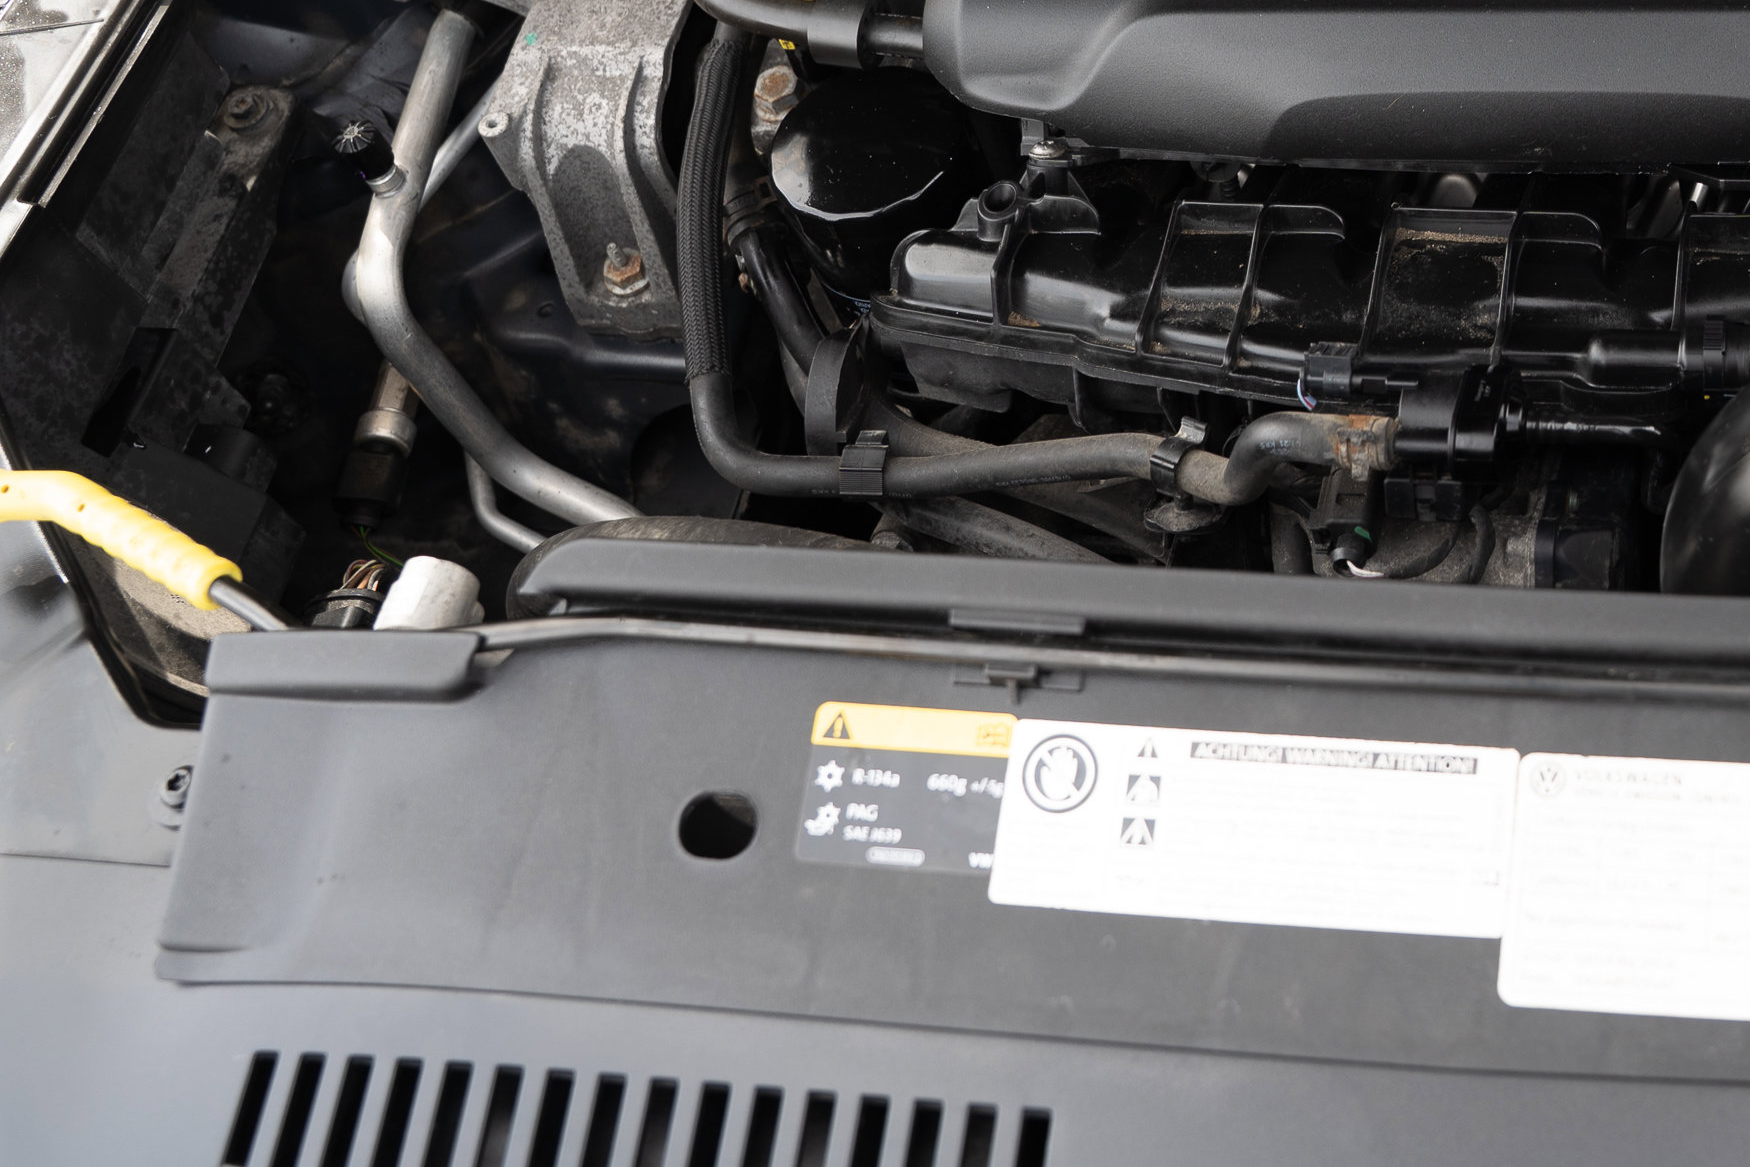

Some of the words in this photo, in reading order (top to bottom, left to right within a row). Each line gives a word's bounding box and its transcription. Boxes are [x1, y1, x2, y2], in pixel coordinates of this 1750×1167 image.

[1194, 742, 1283, 763] ACHTUNG!
[1285, 746, 1373, 769] WARNING!
[1374, 753, 1473, 774] ATTENTION!
[852, 768, 901, 788] R-134a
[845, 802, 879, 822] PAG
[843, 825, 869, 843] SAE
